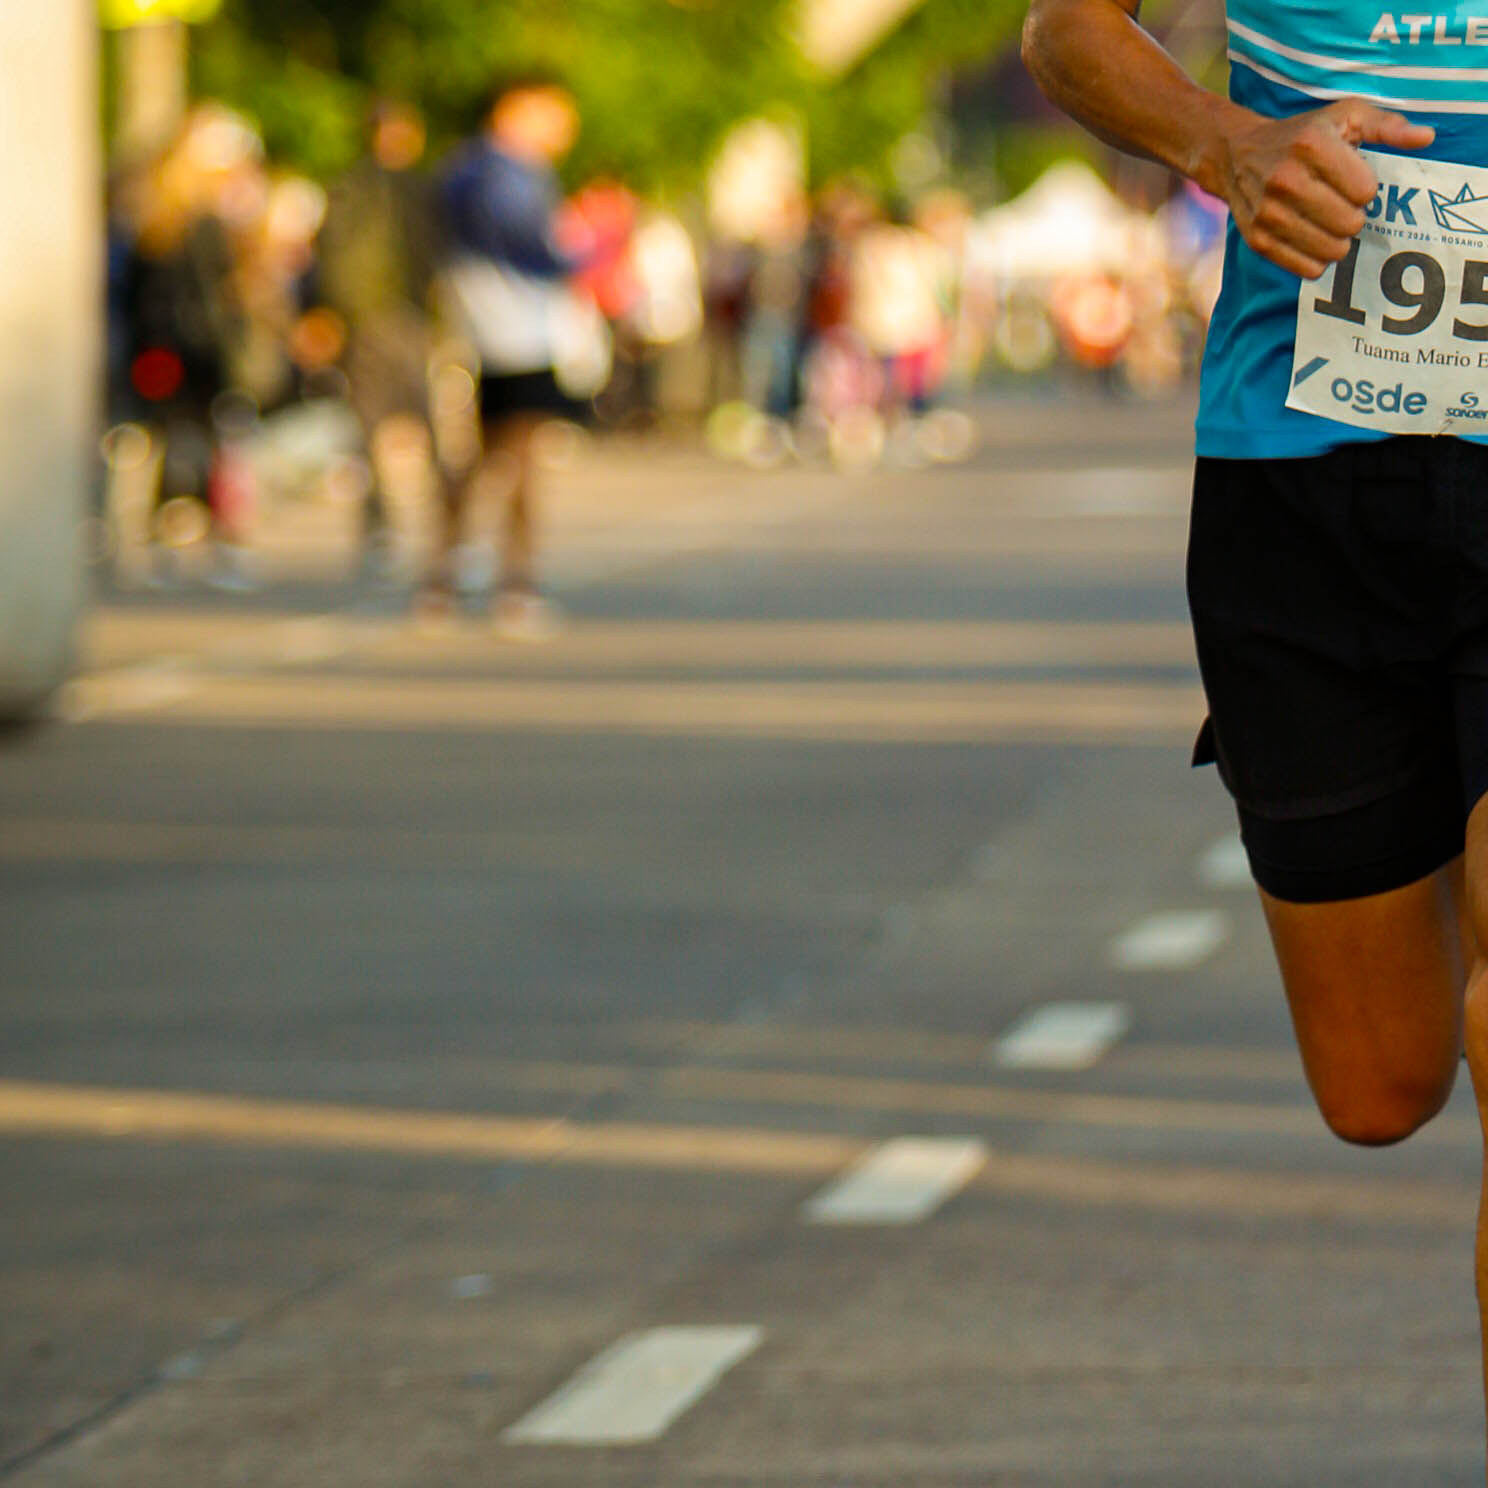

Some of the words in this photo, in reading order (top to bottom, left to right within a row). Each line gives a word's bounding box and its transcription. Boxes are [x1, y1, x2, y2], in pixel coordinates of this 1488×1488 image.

[1374, 223, 1404, 238] NORTE
[1441, 235, 1484, 249] ROSARIO
[1351, 335, 1411, 364] Tuama
[1416, 348, 1471, 368] Mario
[1330, 375, 1428, 416] osde
